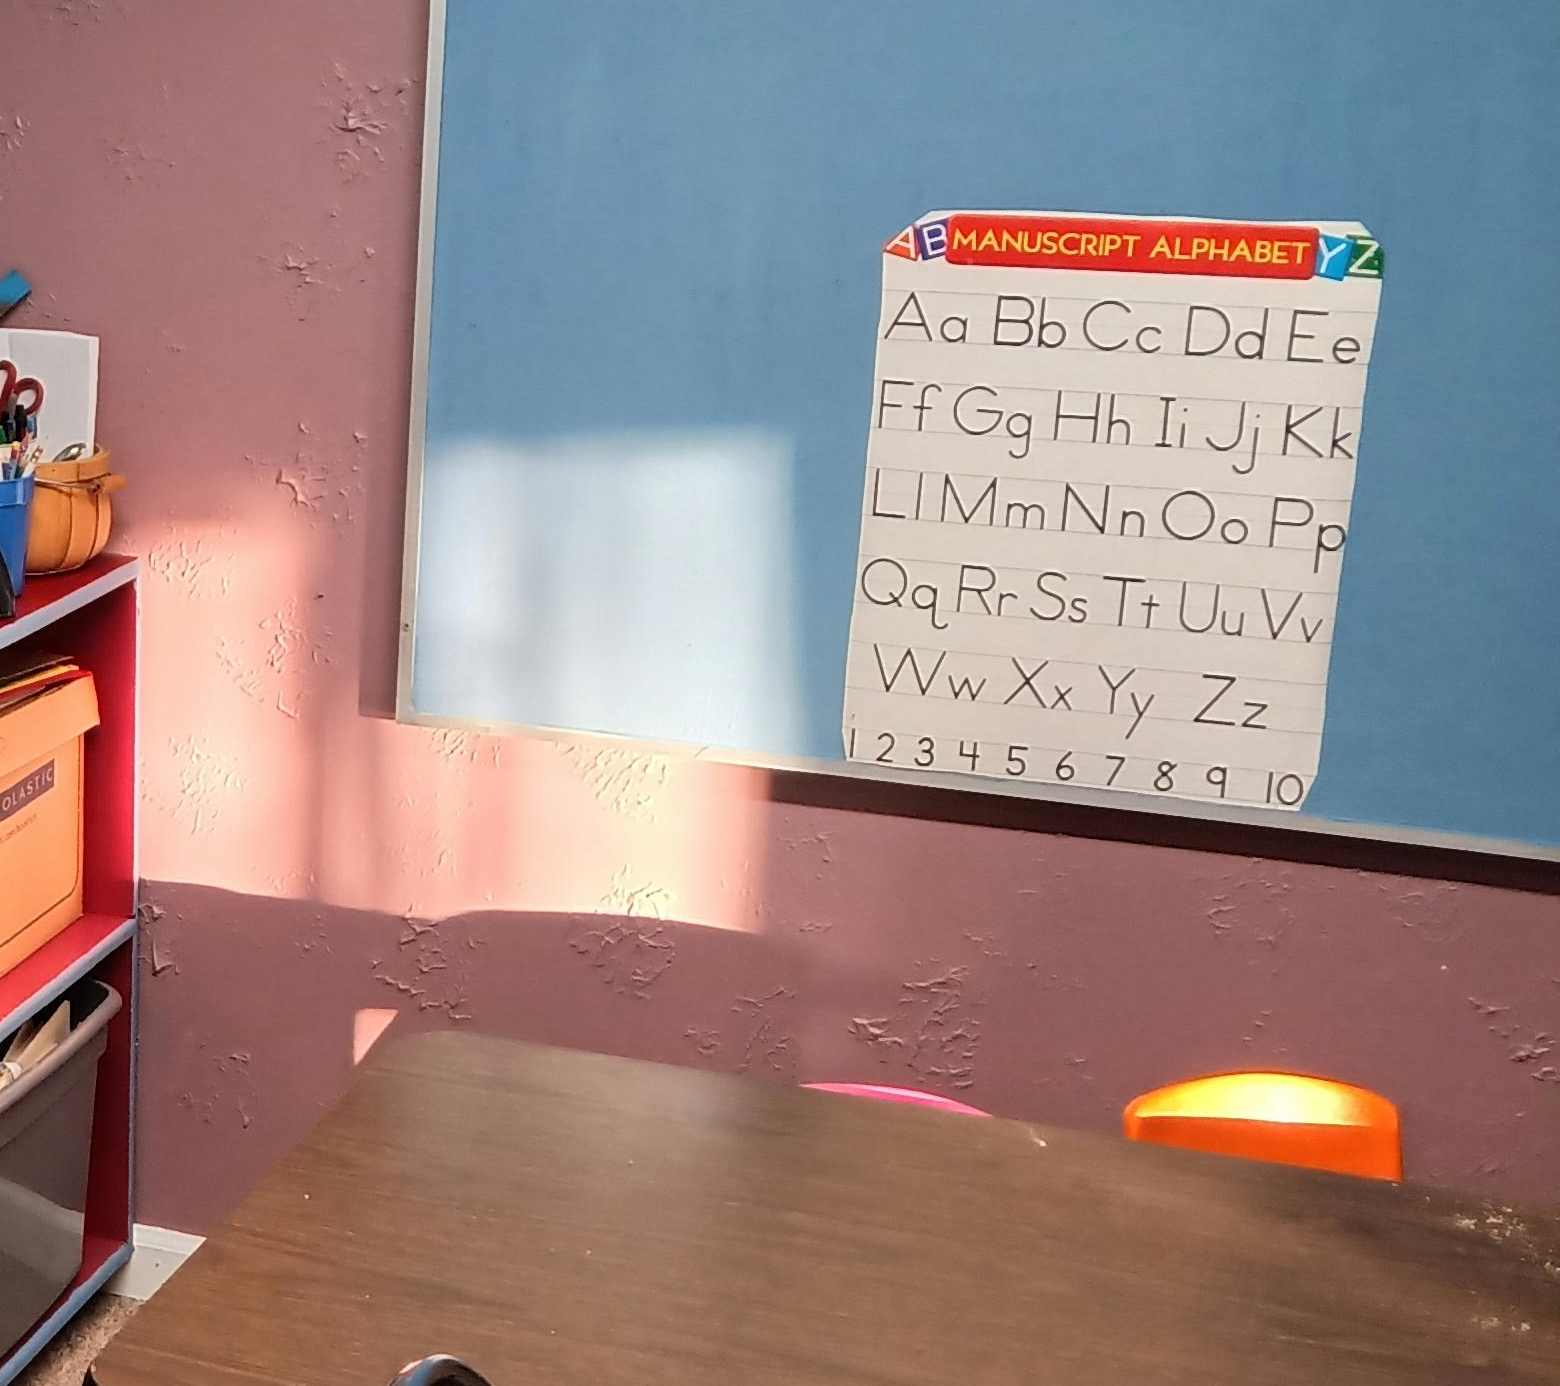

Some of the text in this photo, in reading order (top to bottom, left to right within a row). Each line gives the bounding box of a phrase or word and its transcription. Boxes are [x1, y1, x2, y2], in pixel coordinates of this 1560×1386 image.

[952, 229, 1140, 258] MANUSCRIPT
[1149, 235, 1311, 266] ALPHABET
[849, 727, 1304, 806] 1 2 3 4 5 6 7 8 9 10
